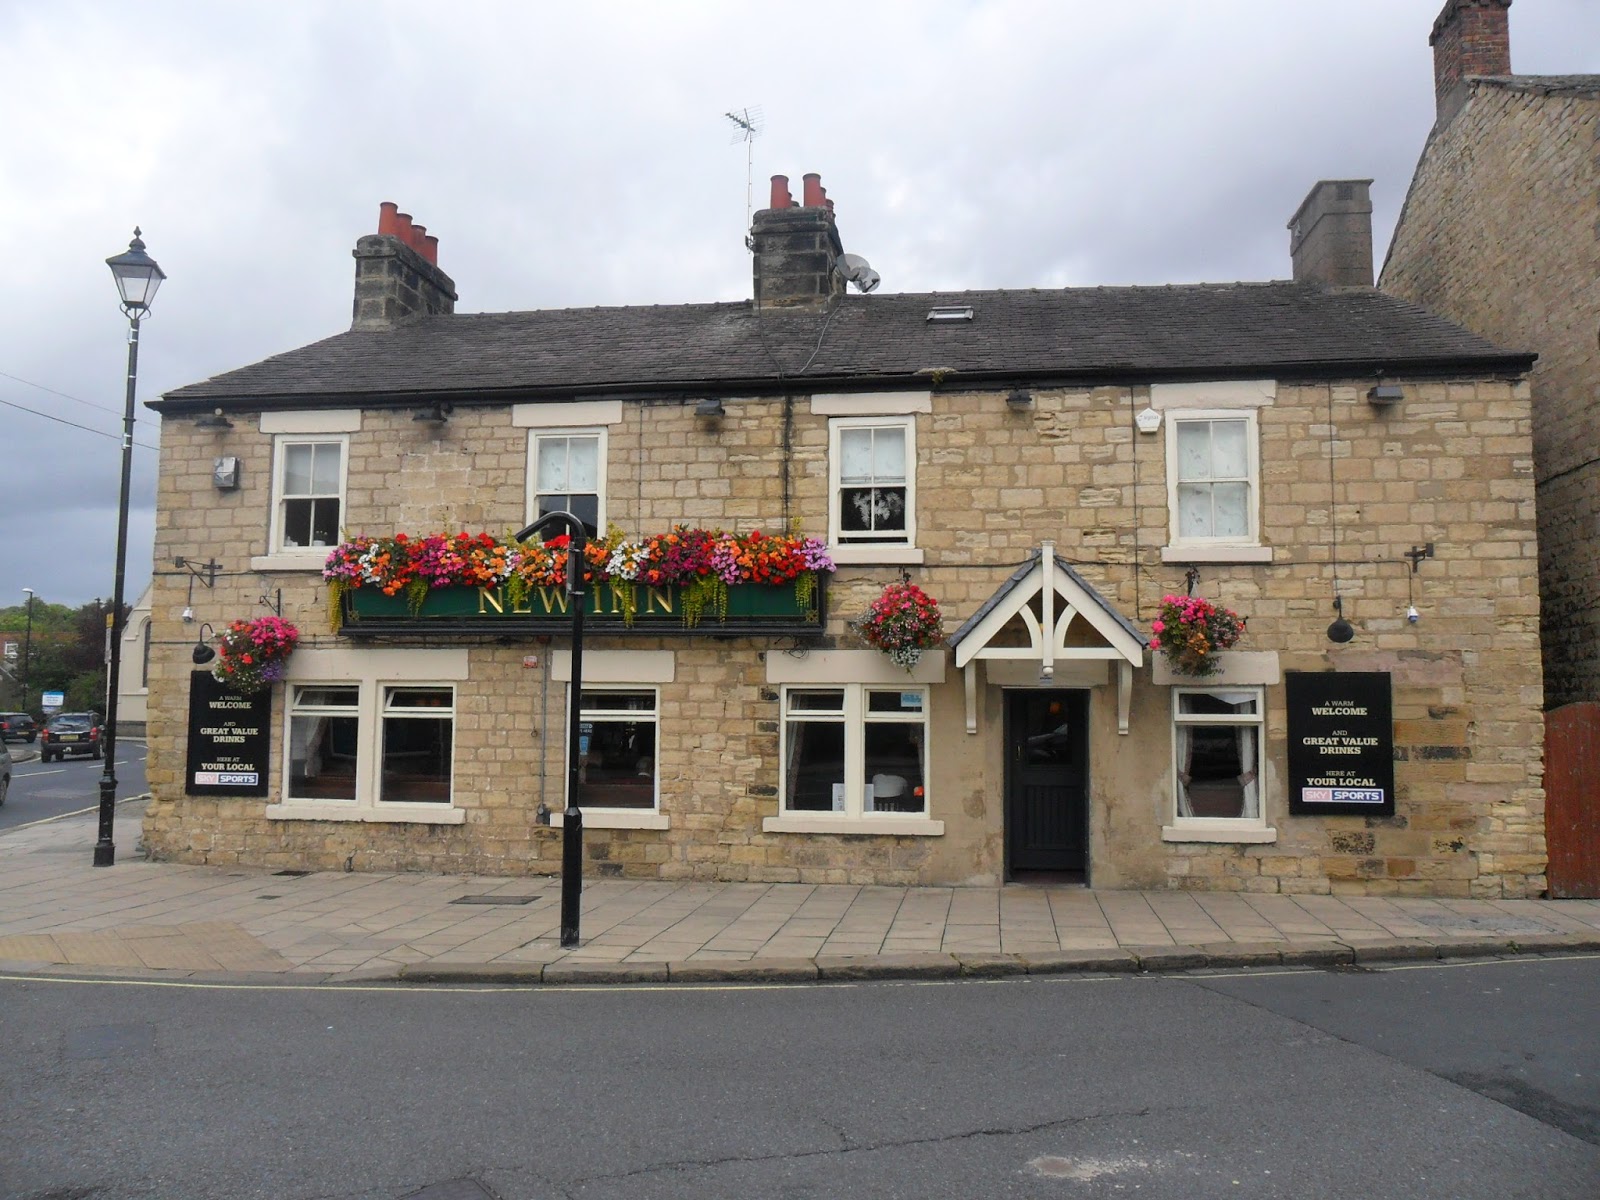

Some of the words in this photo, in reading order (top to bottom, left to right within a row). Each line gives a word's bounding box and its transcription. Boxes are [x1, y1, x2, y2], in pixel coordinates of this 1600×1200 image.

[477, 586, 571, 614] NEW
[592, 585, 673, 614] INN
[209, 701, 252, 709] WELCOME
[1311, 707, 1368, 716] WELCOME
[213, 735, 246, 743] DRINKS
[1302, 737, 1339, 745] GREAT
[1341, 737, 1378, 746] VALUE
[1319, 746, 1361, 755] DRINKS
[226, 763, 255, 771] LOCAL
[197, 773, 216, 782] SKY
[219, 775, 255, 783] SPORTS
[1306, 778, 1337, 786] YOUR
[1339, 778, 1376, 786] LOCAL
[1305, 790, 1328, 800] SKY
[1333, 791, 1380, 800] SPORTS
